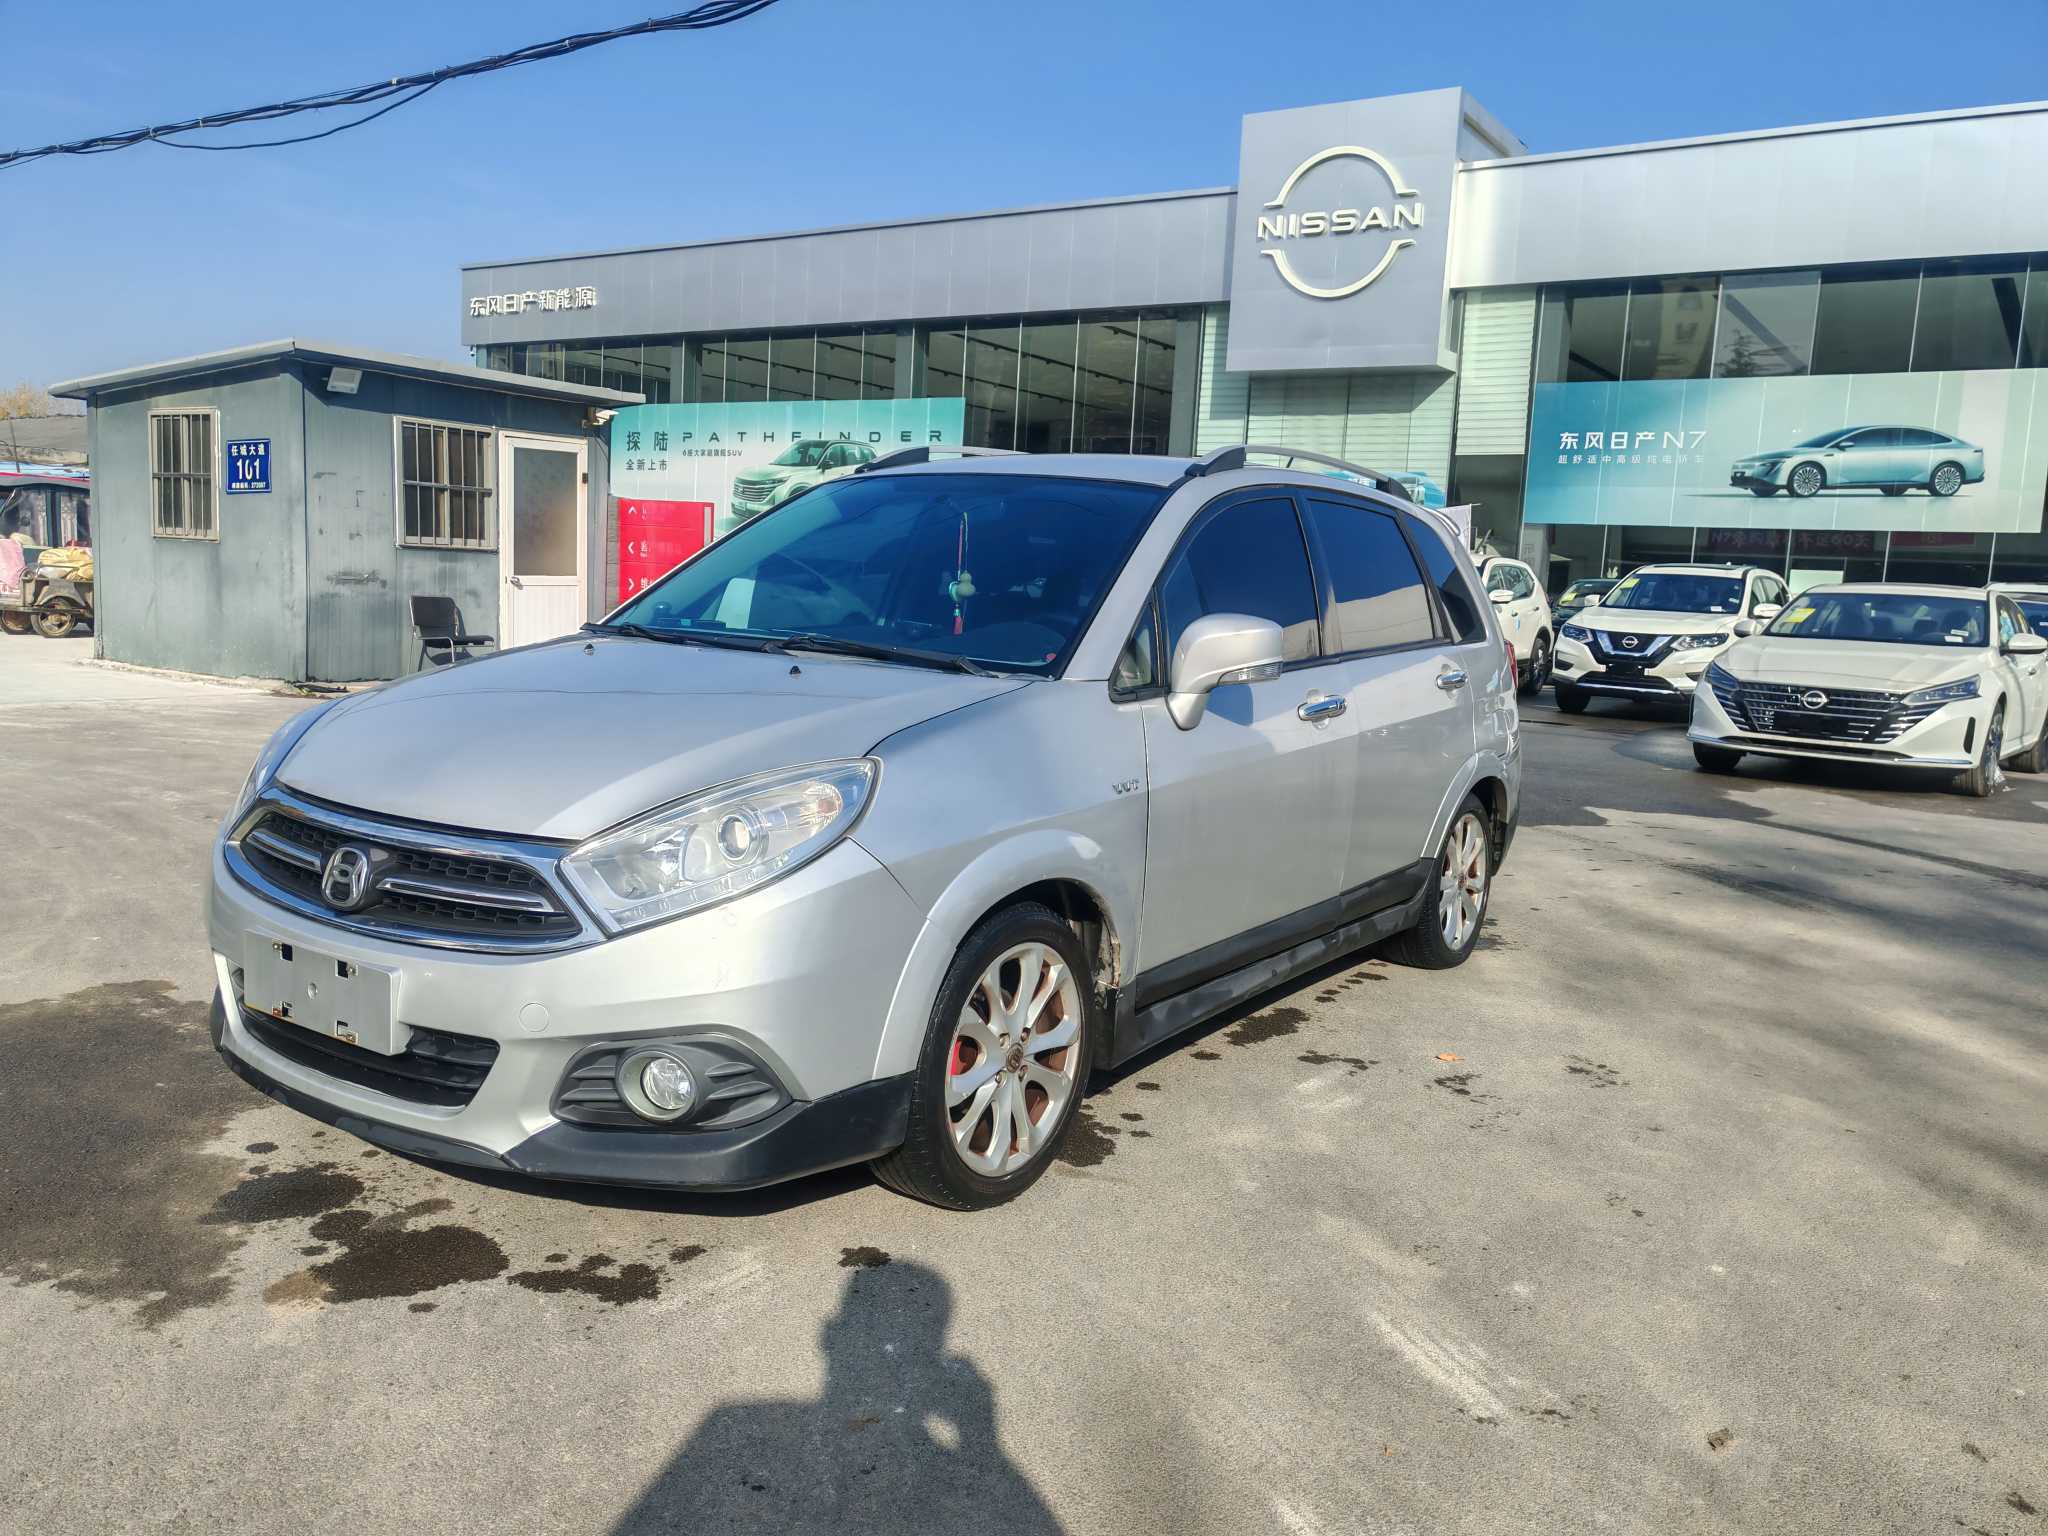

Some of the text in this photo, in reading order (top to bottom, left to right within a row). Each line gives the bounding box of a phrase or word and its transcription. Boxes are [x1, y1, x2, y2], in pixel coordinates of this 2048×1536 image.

[1257, 202, 1424, 240] NISSAN
[470, 286, 597, 316] 东风日产新能源
[626, 430, 942, 452] 探陆 PATHFINDER
[626, 458, 668, 471] 全新上市
